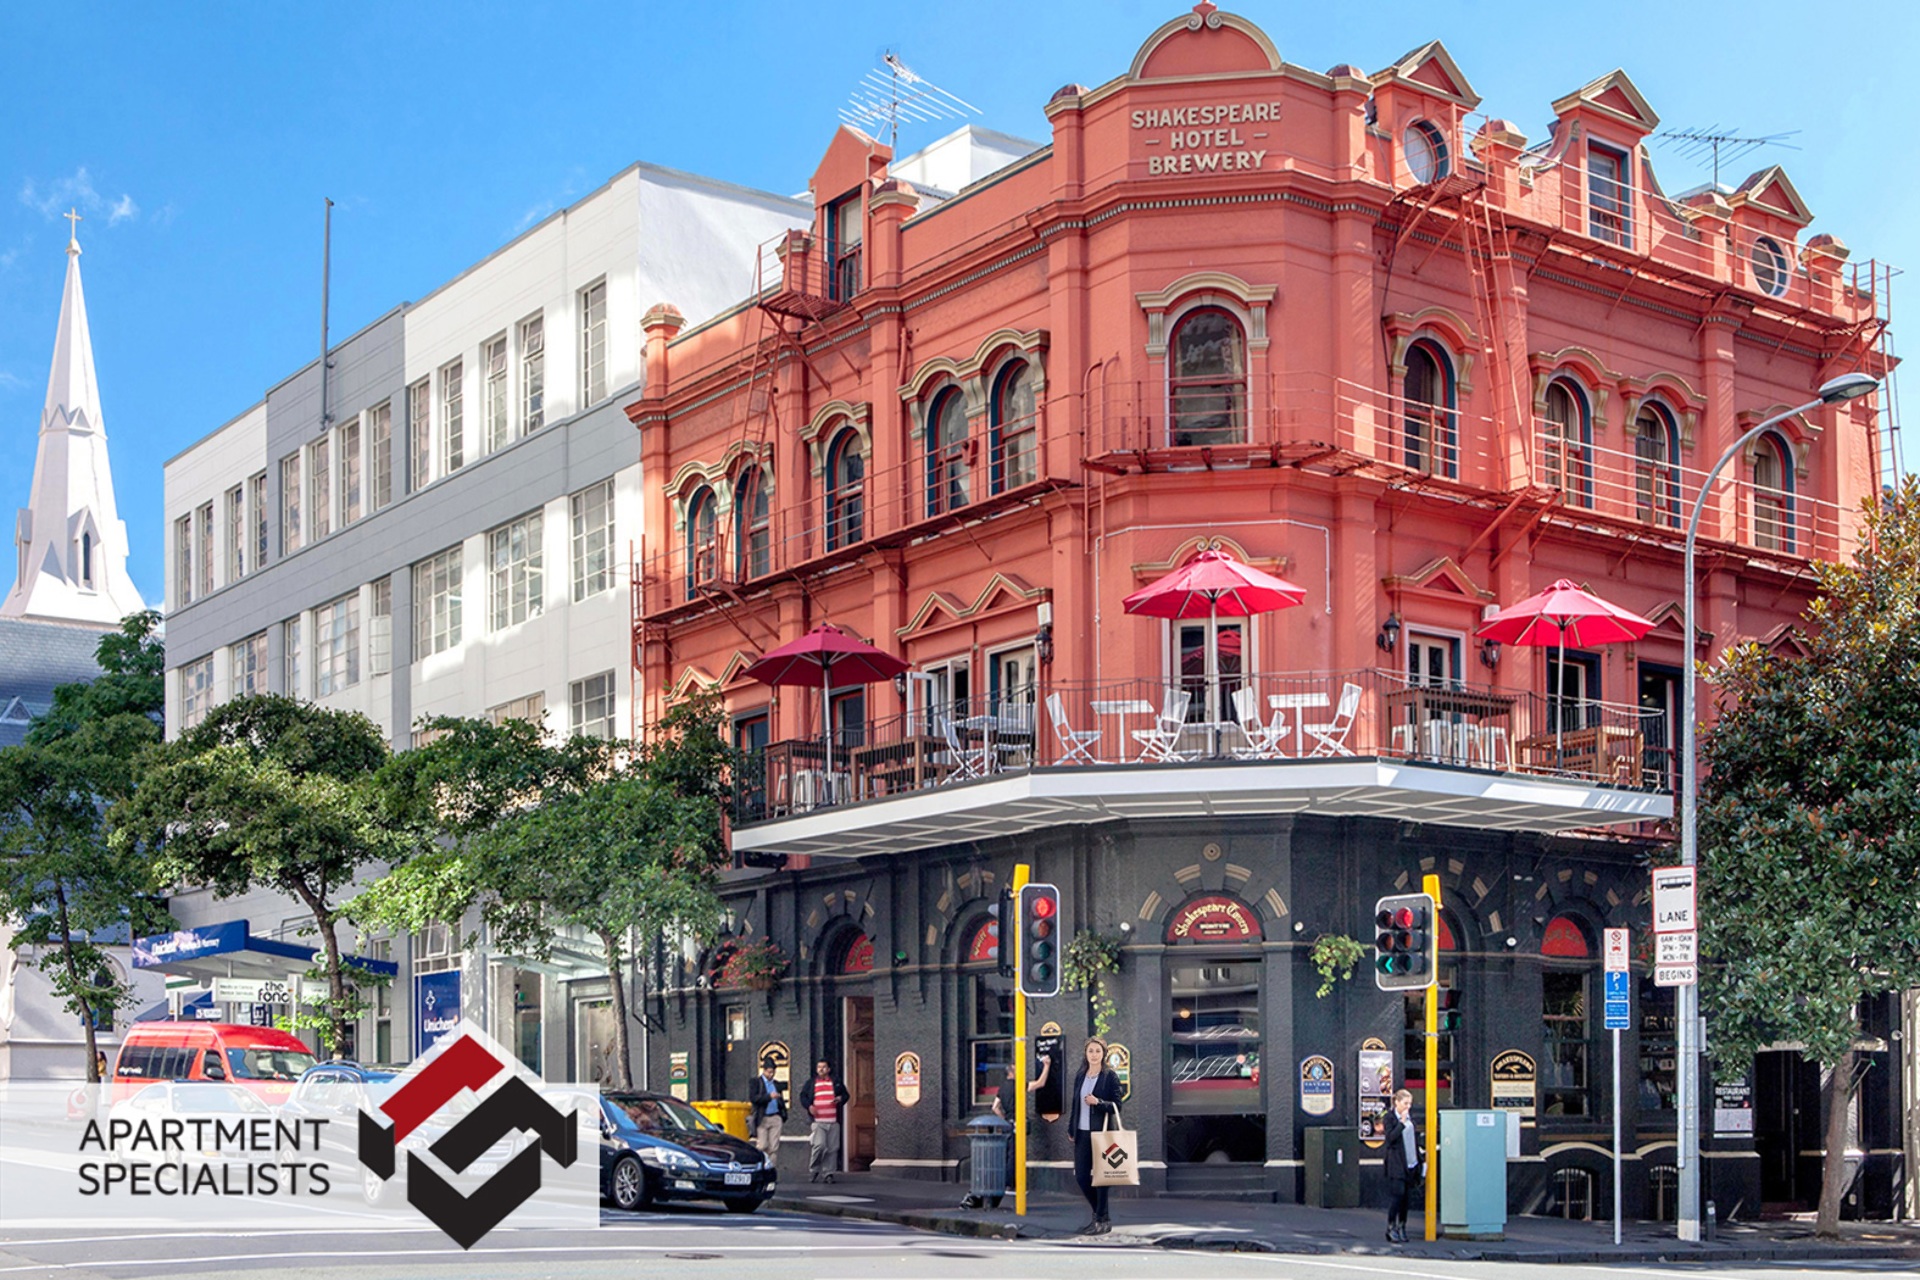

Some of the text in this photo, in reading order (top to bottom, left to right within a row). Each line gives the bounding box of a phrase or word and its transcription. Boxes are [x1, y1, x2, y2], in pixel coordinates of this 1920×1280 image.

[1131, 102, 1281, 129] SHAKESPEARE
[1171, 128, 1245, 150] HOTEL
[1149, 150, 1267, 175] BREWERY
[1174, 902, 1250, 936] Shakespeare Tavern
[1659, 910, 1688, 923] LANE
[1613, 972, 1621, 983] P
[1659, 969, 1693, 981] BEGINS
[265, 981, 284, 992] the
[424, 1016, 455, 1033] Unichem
[1715, 1086, 1751, 1096] RESTAURANT
